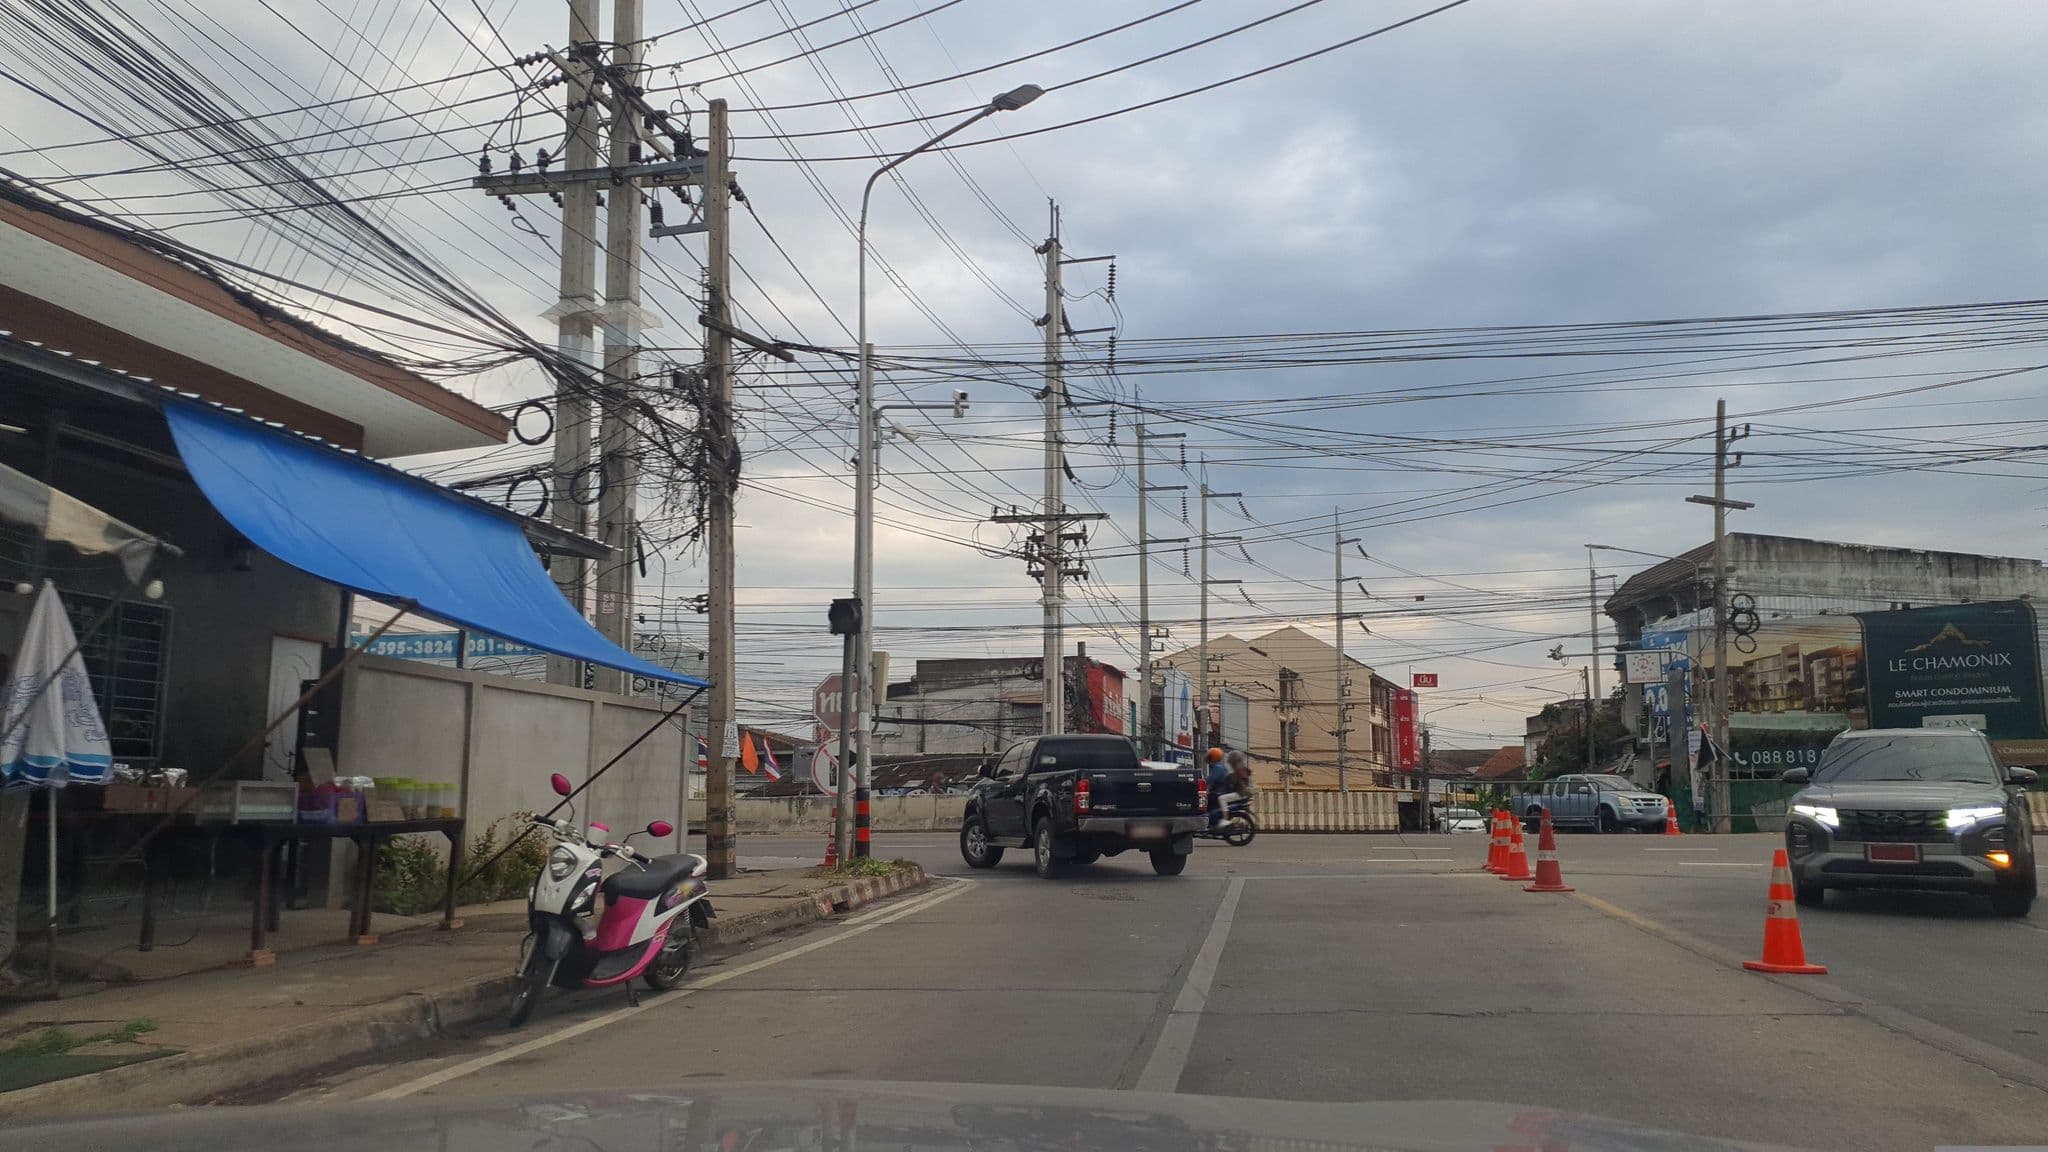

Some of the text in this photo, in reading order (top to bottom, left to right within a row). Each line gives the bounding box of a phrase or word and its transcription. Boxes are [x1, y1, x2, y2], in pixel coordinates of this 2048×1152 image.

[1889, 652, 2012, 672] LE CHAMONIX
[1895, 685, 2012, 699] SMART CONDOMINIUM
[1752, 750, 1781, 764] 088
[1786, 749, 1816, 763] 818
